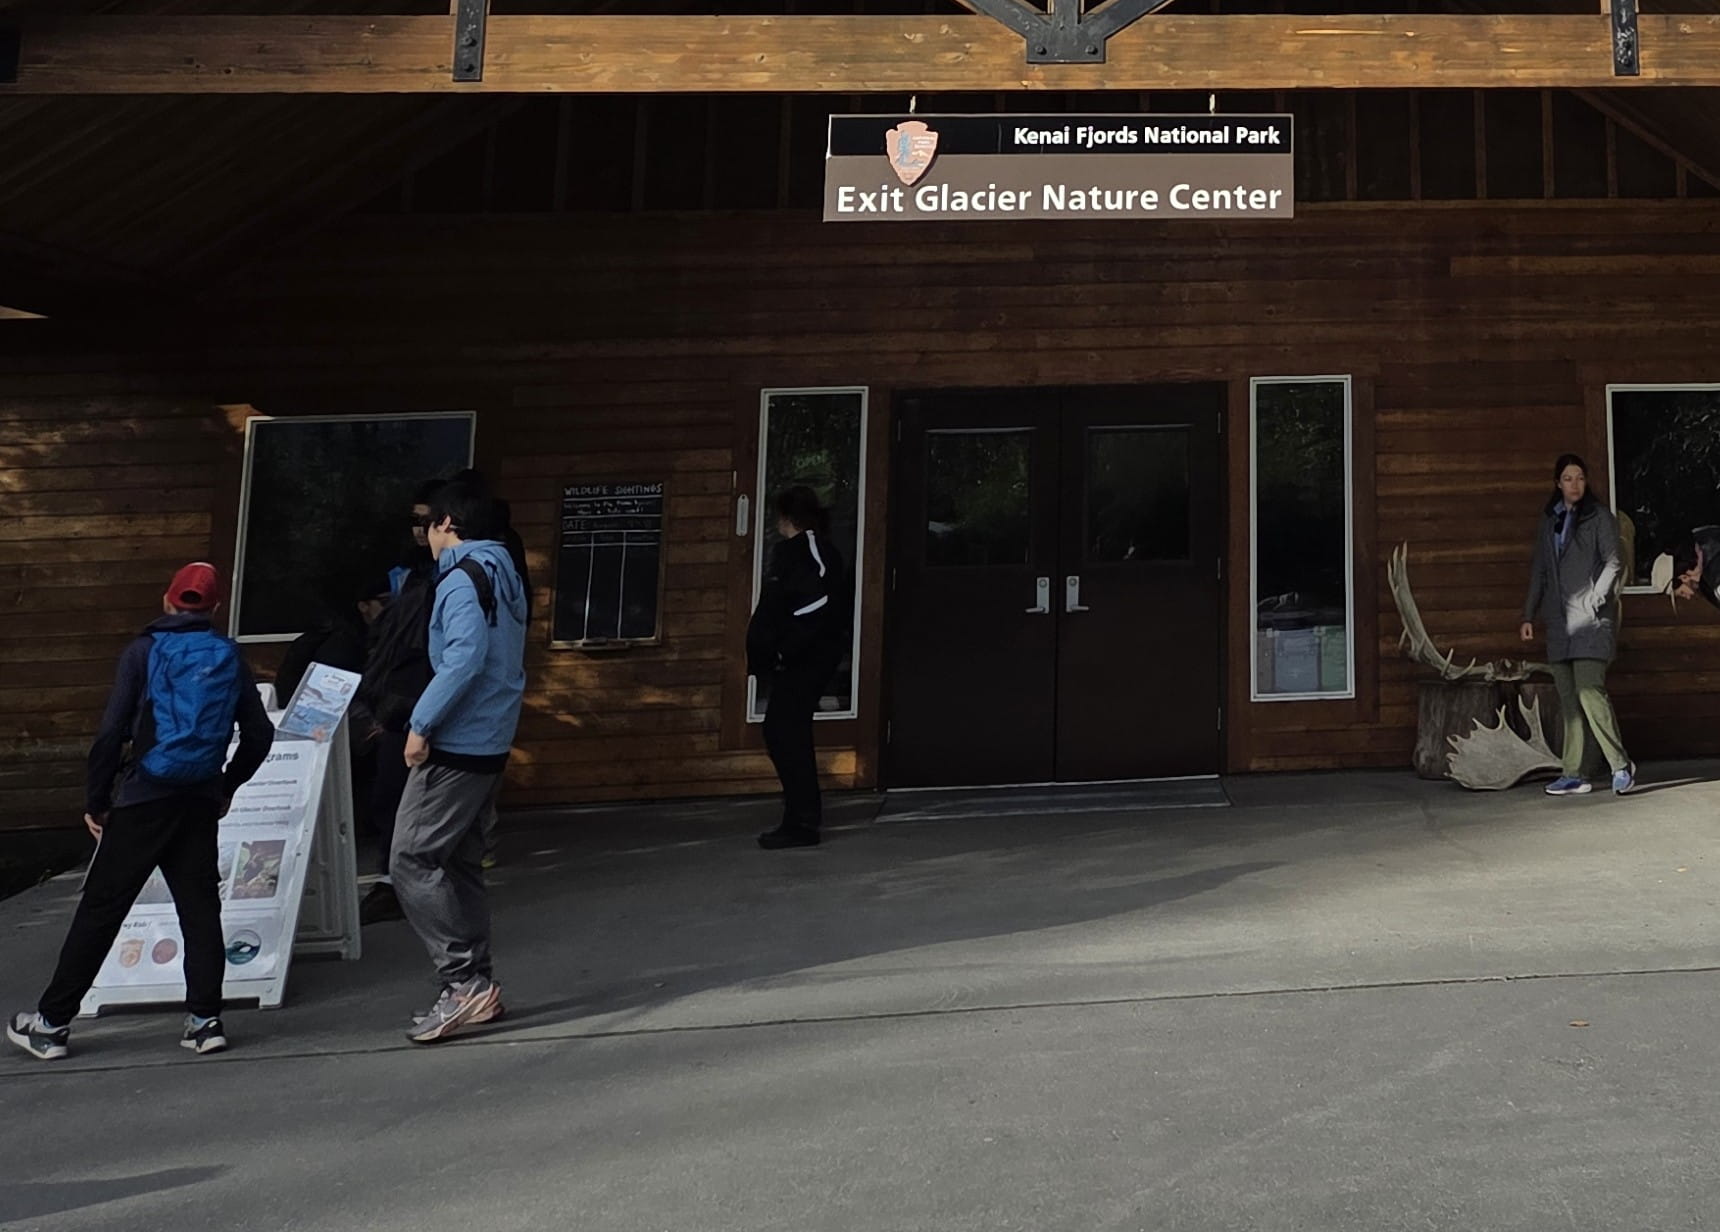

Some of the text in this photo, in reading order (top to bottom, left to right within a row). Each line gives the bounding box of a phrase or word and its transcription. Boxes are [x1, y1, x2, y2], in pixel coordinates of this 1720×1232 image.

[1014, 125, 1281, 149] Kenai Fjords National Park
[837, 183, 1283, 213] Exit Glacier Nature Center
[564, 483, 663, 495] WILDLIFE SIGHTINGS
